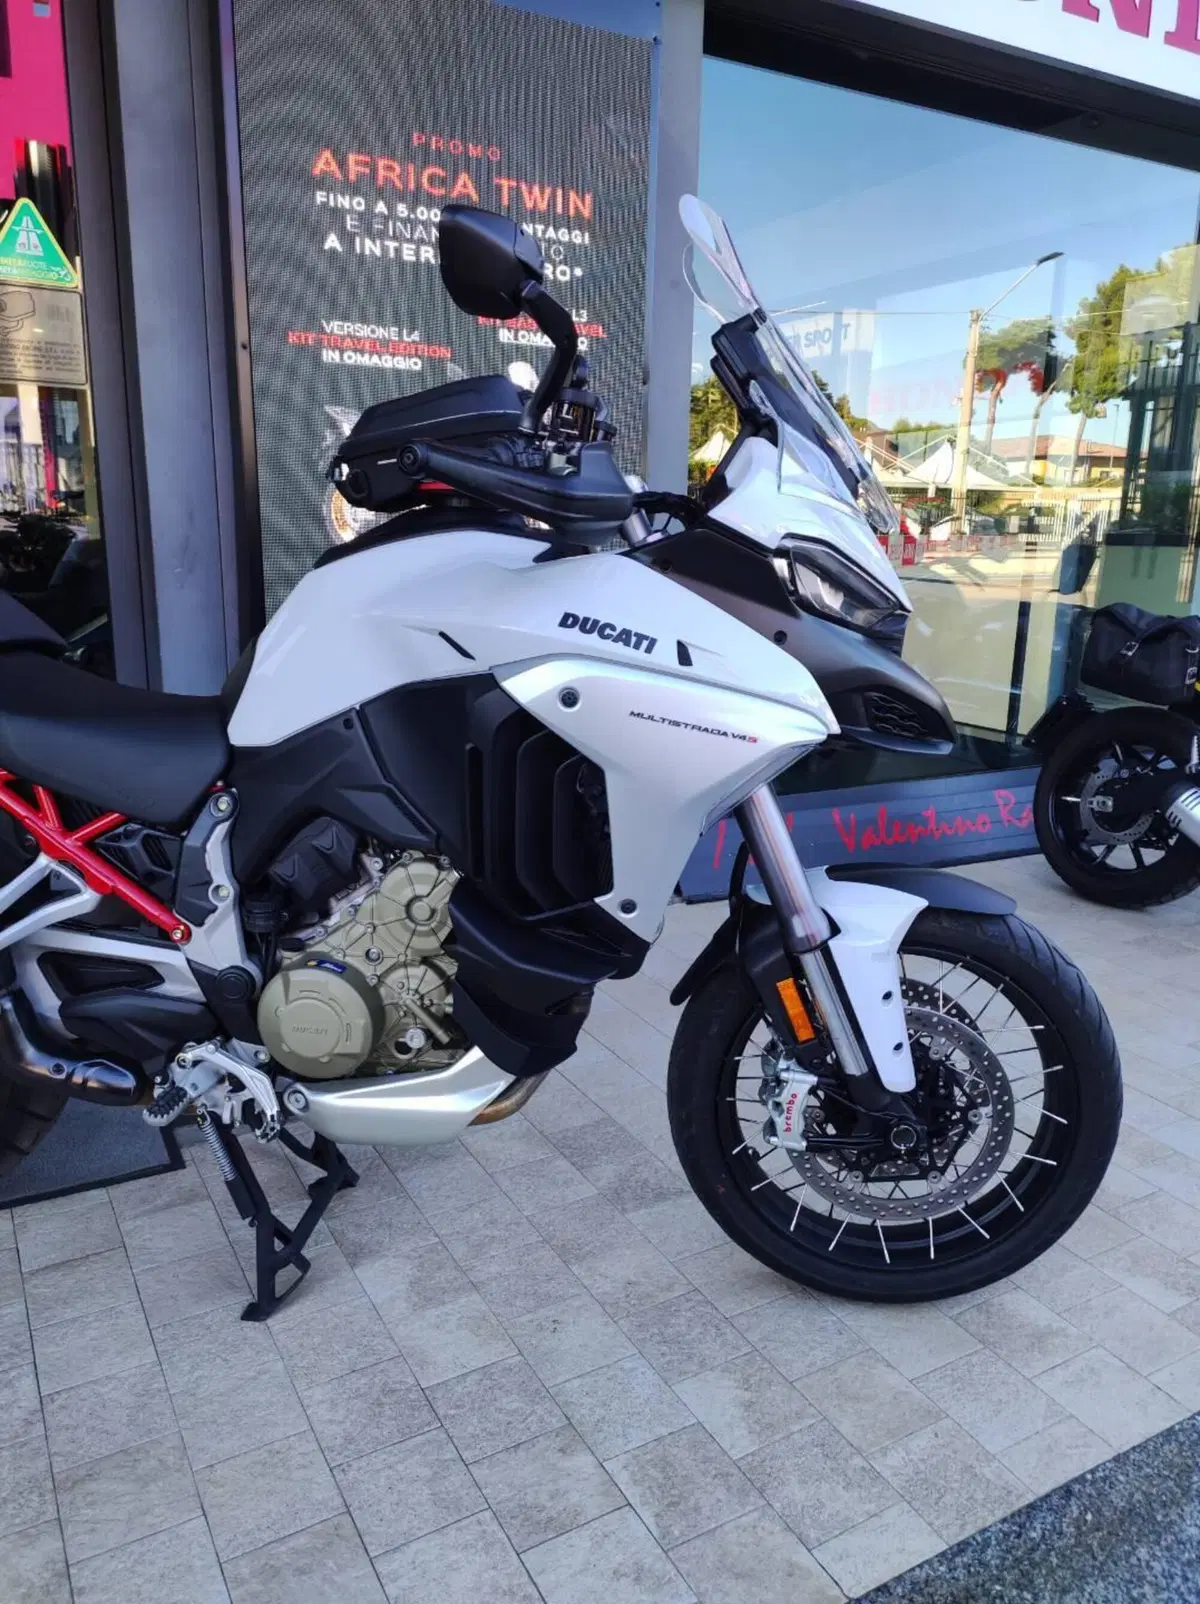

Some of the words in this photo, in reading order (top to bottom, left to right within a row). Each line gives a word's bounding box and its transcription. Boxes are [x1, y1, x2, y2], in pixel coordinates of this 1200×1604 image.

[411, 131, 501, 161] PROMO
[310, 147, 479, 204] AFRICA
[494, 175, 594, 220] TWIN
[316, 190, 366, 212] FINO
[375, 200, 389, 215] A
[396, 202, 441, 222] 5.00
[521, 222, 590, 244] NTAGGI
[346, 214, 360, 233] E
[372, 217, 440, 242] FINAN
[323, 233, 342, 252] A
[355, 236, 440, 265] INTER
[288, 330, 316, 345] KIT
[321, 334, 386, 353] TRAVEL
[388, 340, 452, 359] EDITION
[321, 319, 398, 341] VERSIONE
[402, 328, 420, 342] L4
[499, 328, 515, 342] IN
[803, 322, 851, 348] SPOT
[322, 348, 340, 363] IN
[343, 351, 423, 371] OMAGGIO
[558, 611, 658, 655] DUCATI
[629, 710, 730, 738] MULTISTRADA
[832, 805, 991, 853] Valentino
[783, 1092, 798, 1133] brembo
